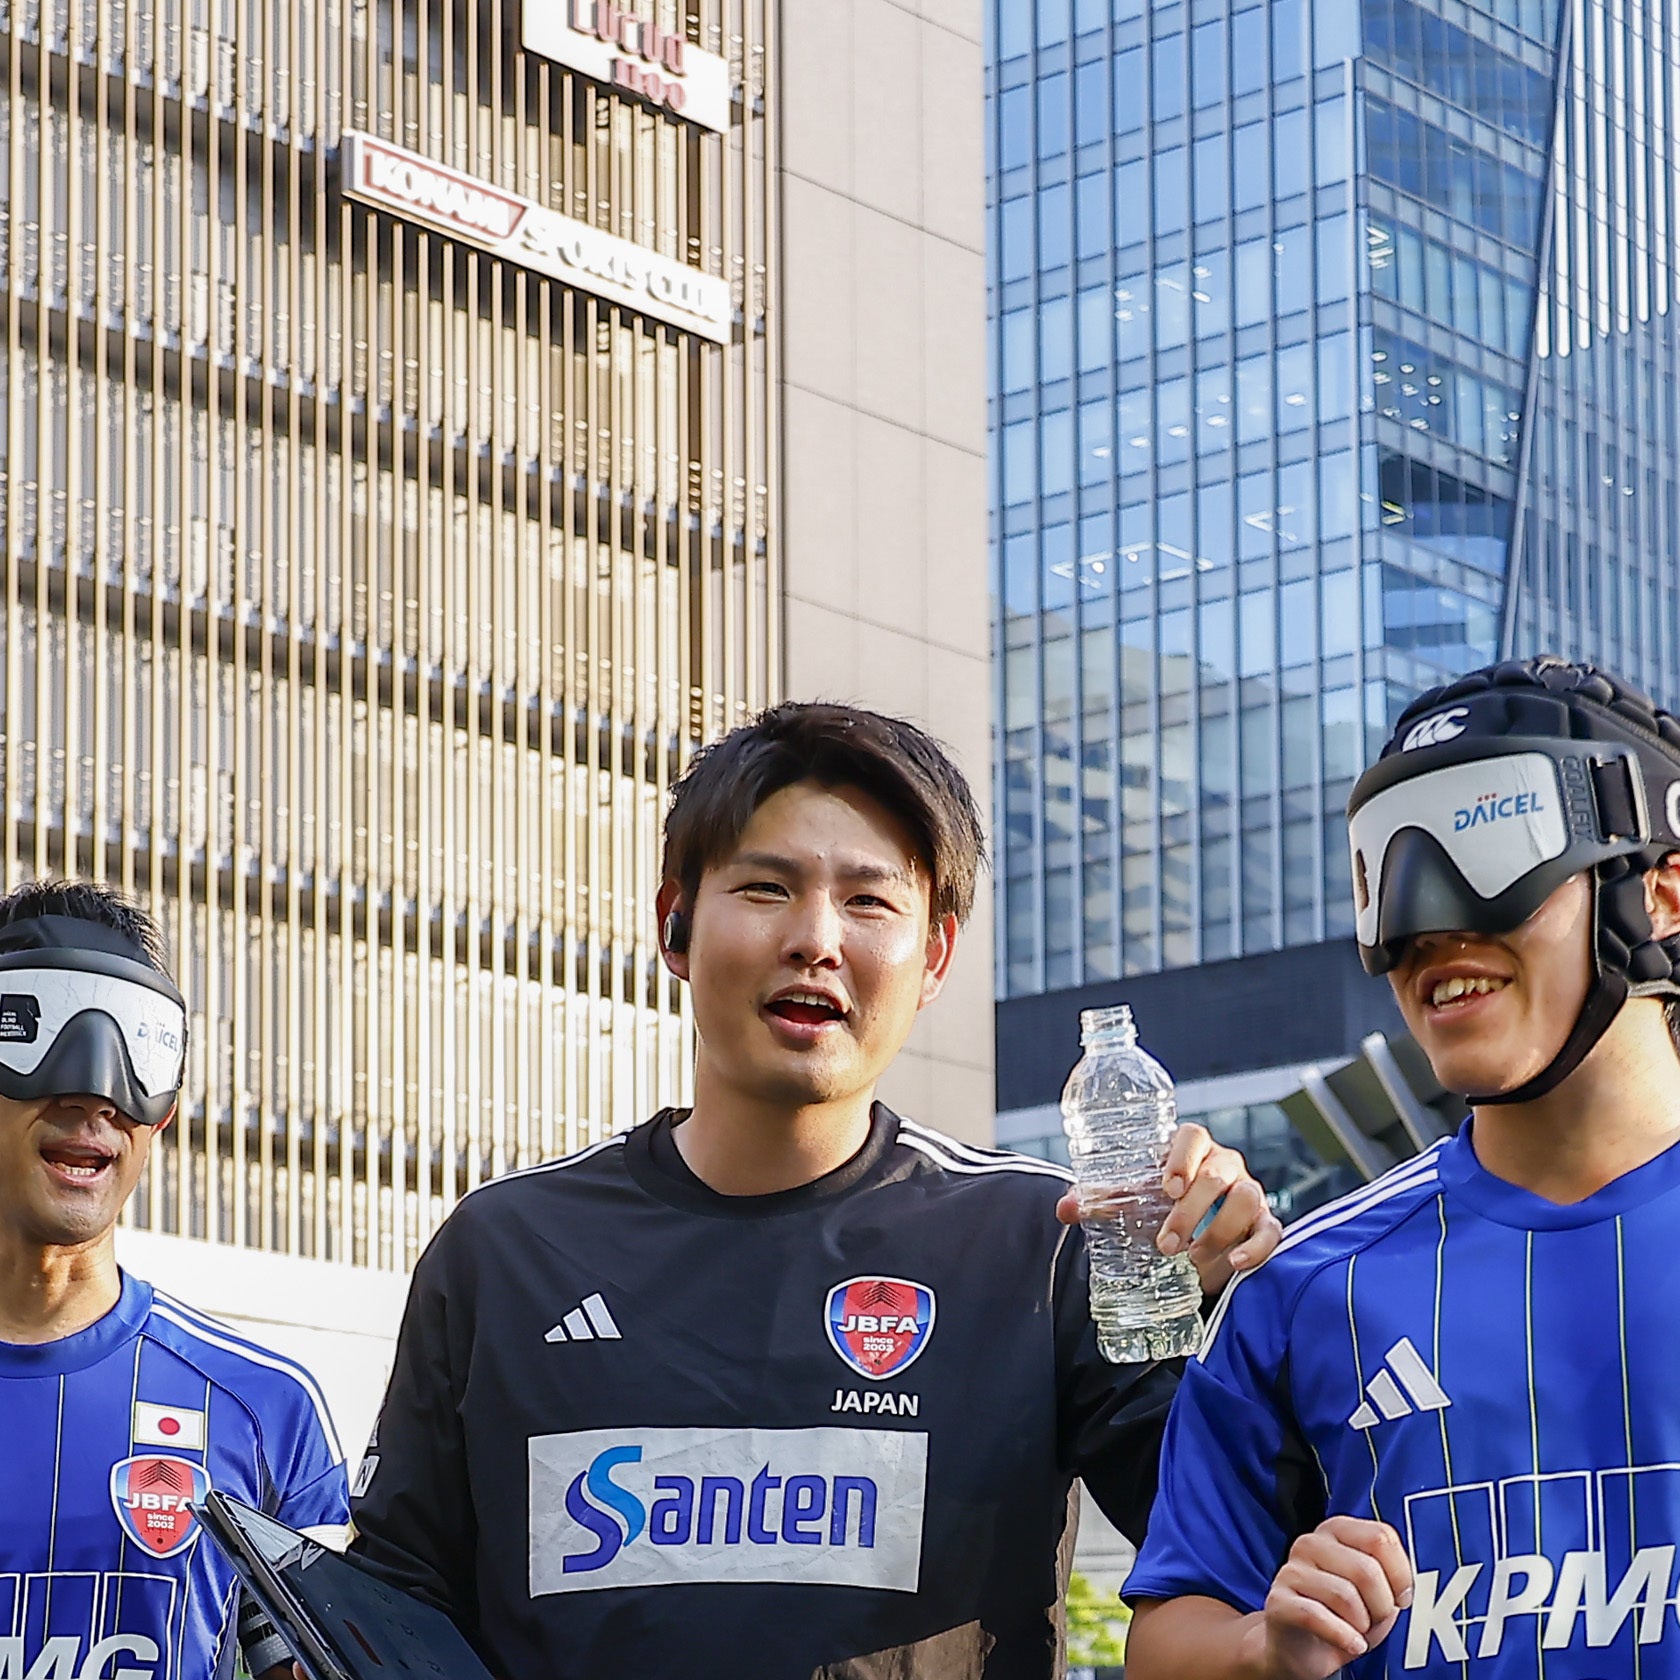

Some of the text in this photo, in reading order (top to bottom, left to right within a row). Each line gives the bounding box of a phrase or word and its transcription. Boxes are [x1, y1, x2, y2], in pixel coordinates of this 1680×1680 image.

[371, 149, 510, 237] KONAMI
[1454, 792, 1544, 833] DAICEL
[137, 1022, 179, 1052] DICEL
[837, 1315, 920, 1334] JBFA
[863, 1336, 894, 1344] since
[831, 1389, 919, 1417] JAPAN
[147, 1512, 175, 1521] since
[562, 1445, 878, 1575] Santen
[147, 1520, 175, 1529] 2002
